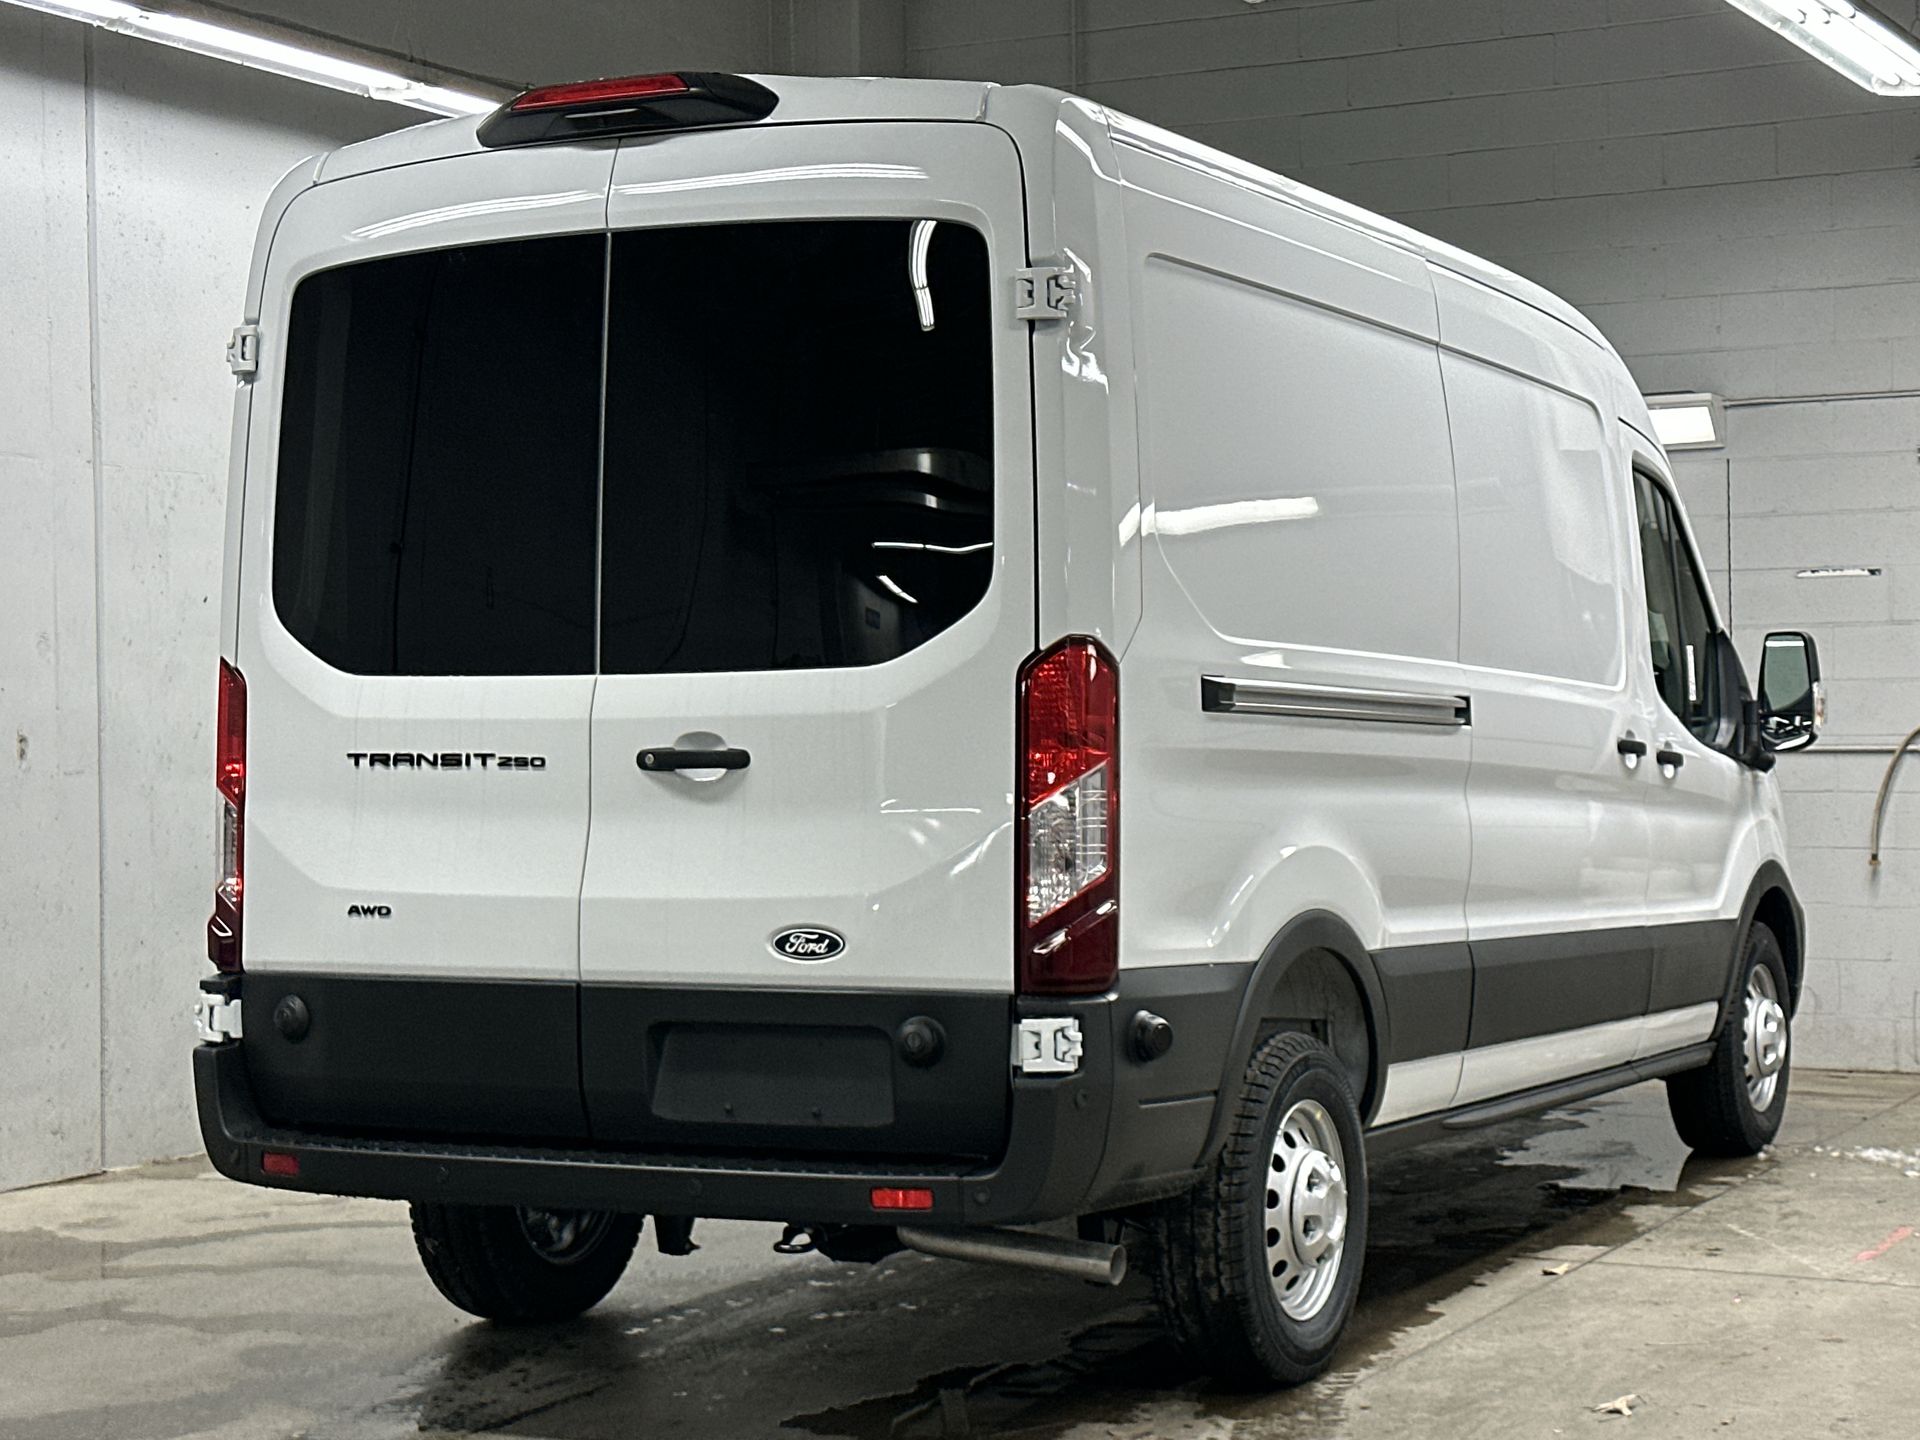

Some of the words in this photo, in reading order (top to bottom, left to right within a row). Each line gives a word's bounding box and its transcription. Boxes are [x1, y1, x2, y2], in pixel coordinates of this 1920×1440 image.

[347, 752, 496, 769] TRANSIT
[496, 756, 546, 769] 250
[347, 904, 392, 917] AWD
[785, 932, 830, 954] Ford
